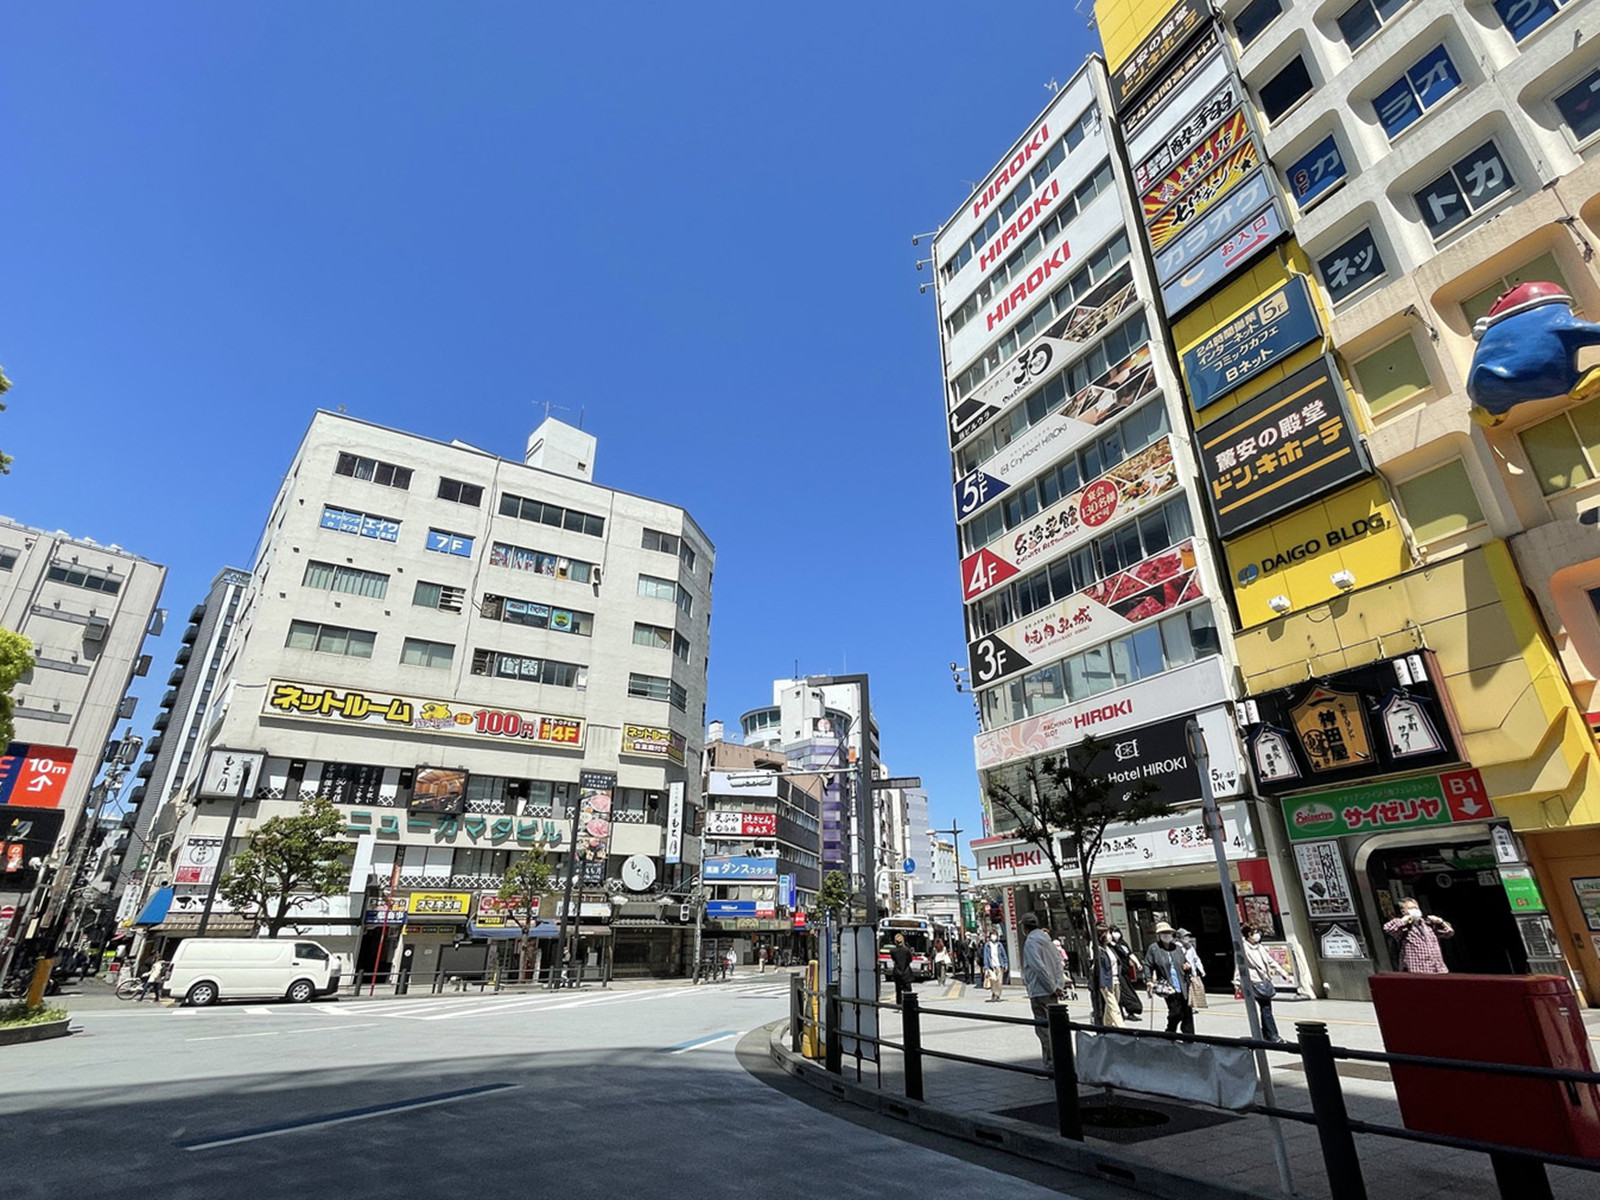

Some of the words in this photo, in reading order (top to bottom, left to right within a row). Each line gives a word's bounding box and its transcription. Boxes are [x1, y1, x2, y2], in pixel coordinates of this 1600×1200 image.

[1215, 132, 1232, 151] 7F
[973, 123, 1050, 219] HIROKI
[1311, 149, 1340, 182] カ
[1294, 169, 1310, 196] 6F
[979, 178, 1060, 273] HIROKI
[1162, 183, 1260, 274] カラオケ
[1220, 215, 1268, 257] お入口
[1326, 243, 1374, 289] ネッ
[986, 240, 1072, 332] HIROKI
[1260, 299, 1285, 325] 5F
[1197, 323, 1260, 366] インターネット
[1213, 325, 1280, 372] コミックカフェ
[1225, 347, 1274, 382] Bネット
[1215, 399, 1328, 473] 驚安の殿堂
[1081, 491, 1117, 518] 130名様
[364, 518, 398, 533] エイワ
[436, 535, 464, 551] 7F
[1260, 538, 1322, 574] DAIGO
[967, 553, 998, 592] 4F
[976, 639, 1008, 682] 3F
[270, 684, 413, 724] ネットルーム
[1073, 699, 1133, 729] HIROKI
[474, 708, 535, 740] 100円
[551, 725, 577, 742] 4F
[1042, 717, 1073, 731] PACHINKO
[1044, 729, 1059, 738] SLOT
[1317, 709, 1351, 762] 神田屋
[1404, 713, 1419, 732] 下町
[1397, 724, 1412, 753] サワー
[29, 757, 67, 776] 10m
[1107, 766, 1141, 785] Hotel
[1142, 756, 1188, 777] HIROKI
[1213, 781, 1226, 793] IN
[1448, 776, 1479, 795] B1
[346, 809, 563, 843] ニューカマタビル
[1343, 796, 1441, 828] サイゼリヤ
[1143, 848, 1154, 860] 3F
[1233, 836, 1246, 849] 4F
[987, 849, 1041, 871] HIROKI
[1515, 896, 1530, 908] B1
